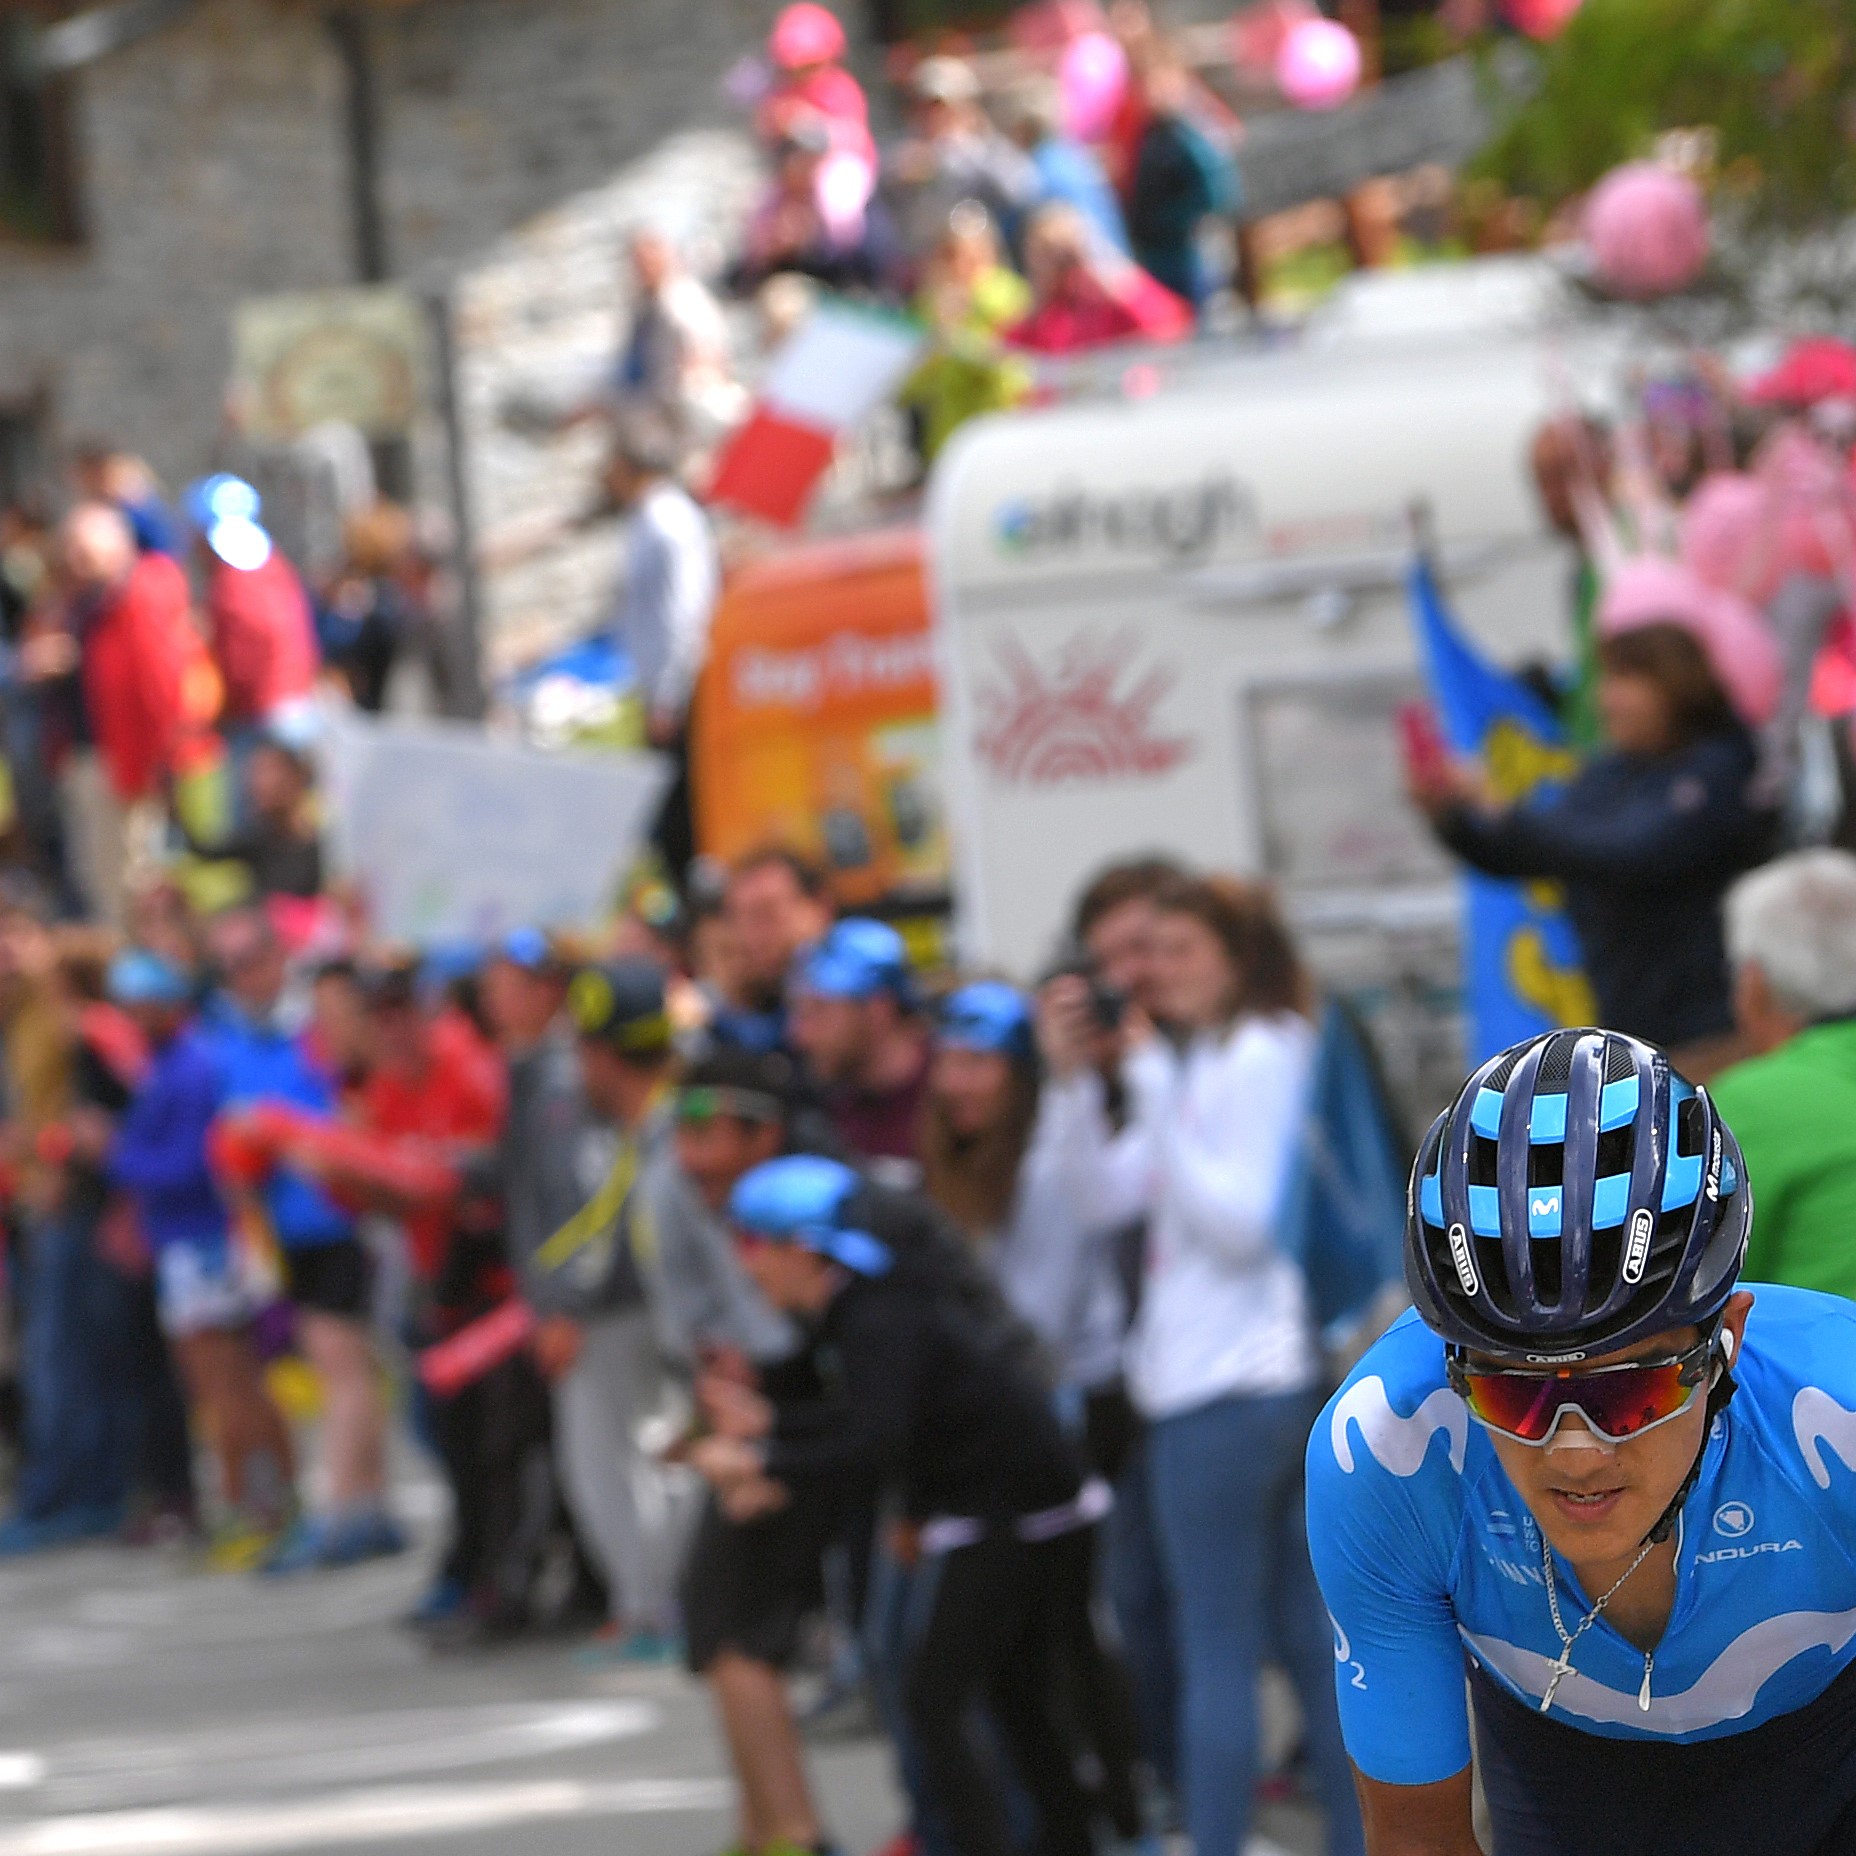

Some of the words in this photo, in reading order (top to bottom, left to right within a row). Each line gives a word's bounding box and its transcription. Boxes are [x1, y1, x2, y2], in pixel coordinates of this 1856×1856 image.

[1450, 1231, 1476, 1290] ABUS
[1626, 1215, 1651, 1277] ABUS
[1691, 1539, 1804, 1572] NDURA
